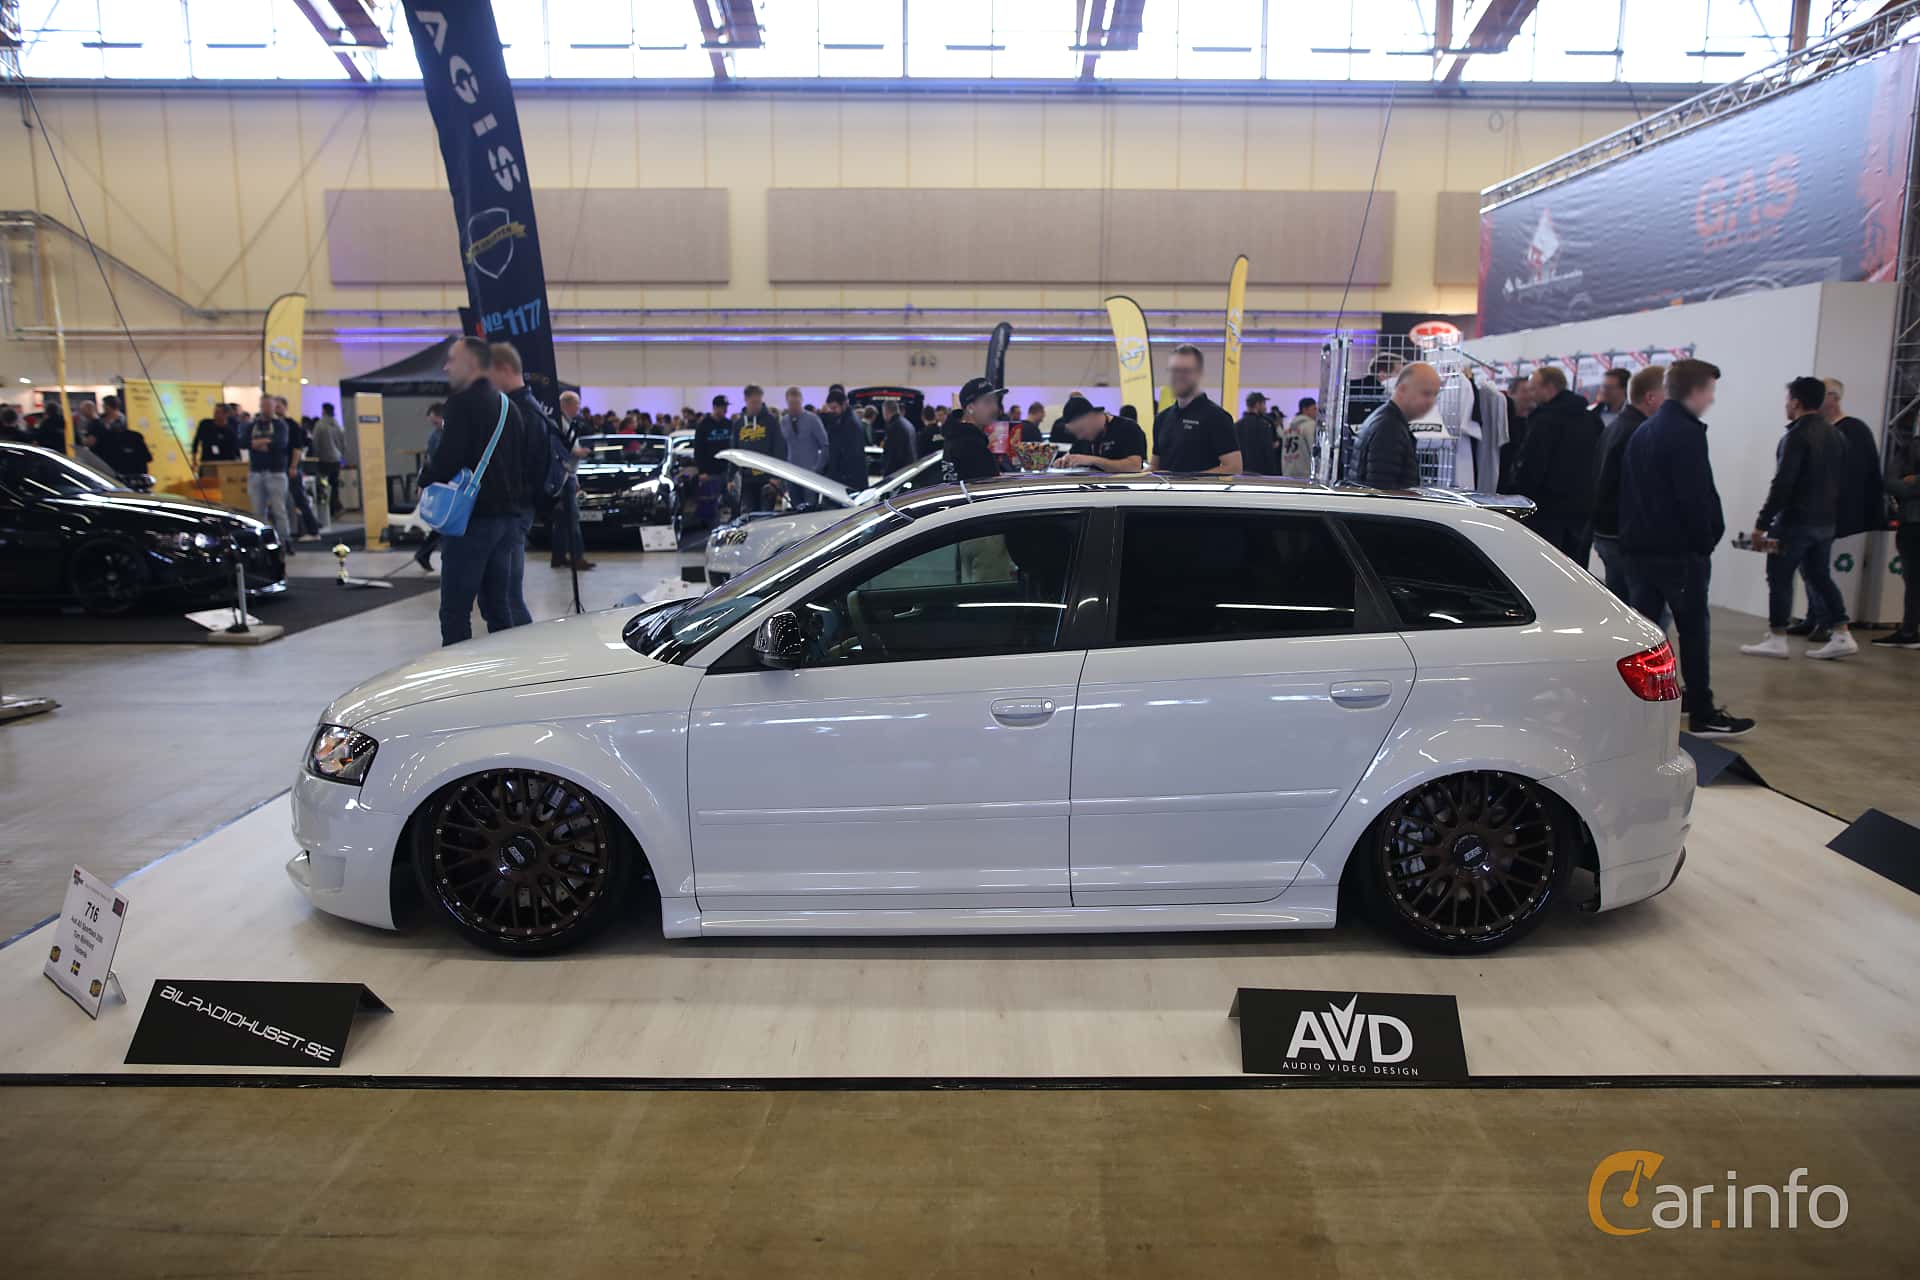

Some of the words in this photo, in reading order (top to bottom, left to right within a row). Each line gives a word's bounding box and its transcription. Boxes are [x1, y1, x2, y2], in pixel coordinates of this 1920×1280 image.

[1696, 154, 1798, 238] GAS
[85, 902, 100, 922] 716
[160, 985, 335, 1061] BILRADIOHUSET.SE
[1286, 993, 1413, 1063] AVD
[1282, 1061, 1321, 1071] AUDIO
[1328, 1063, 1366, 1073] VIDEO
[1373, 1065, 1419, 1076] DESIGN
